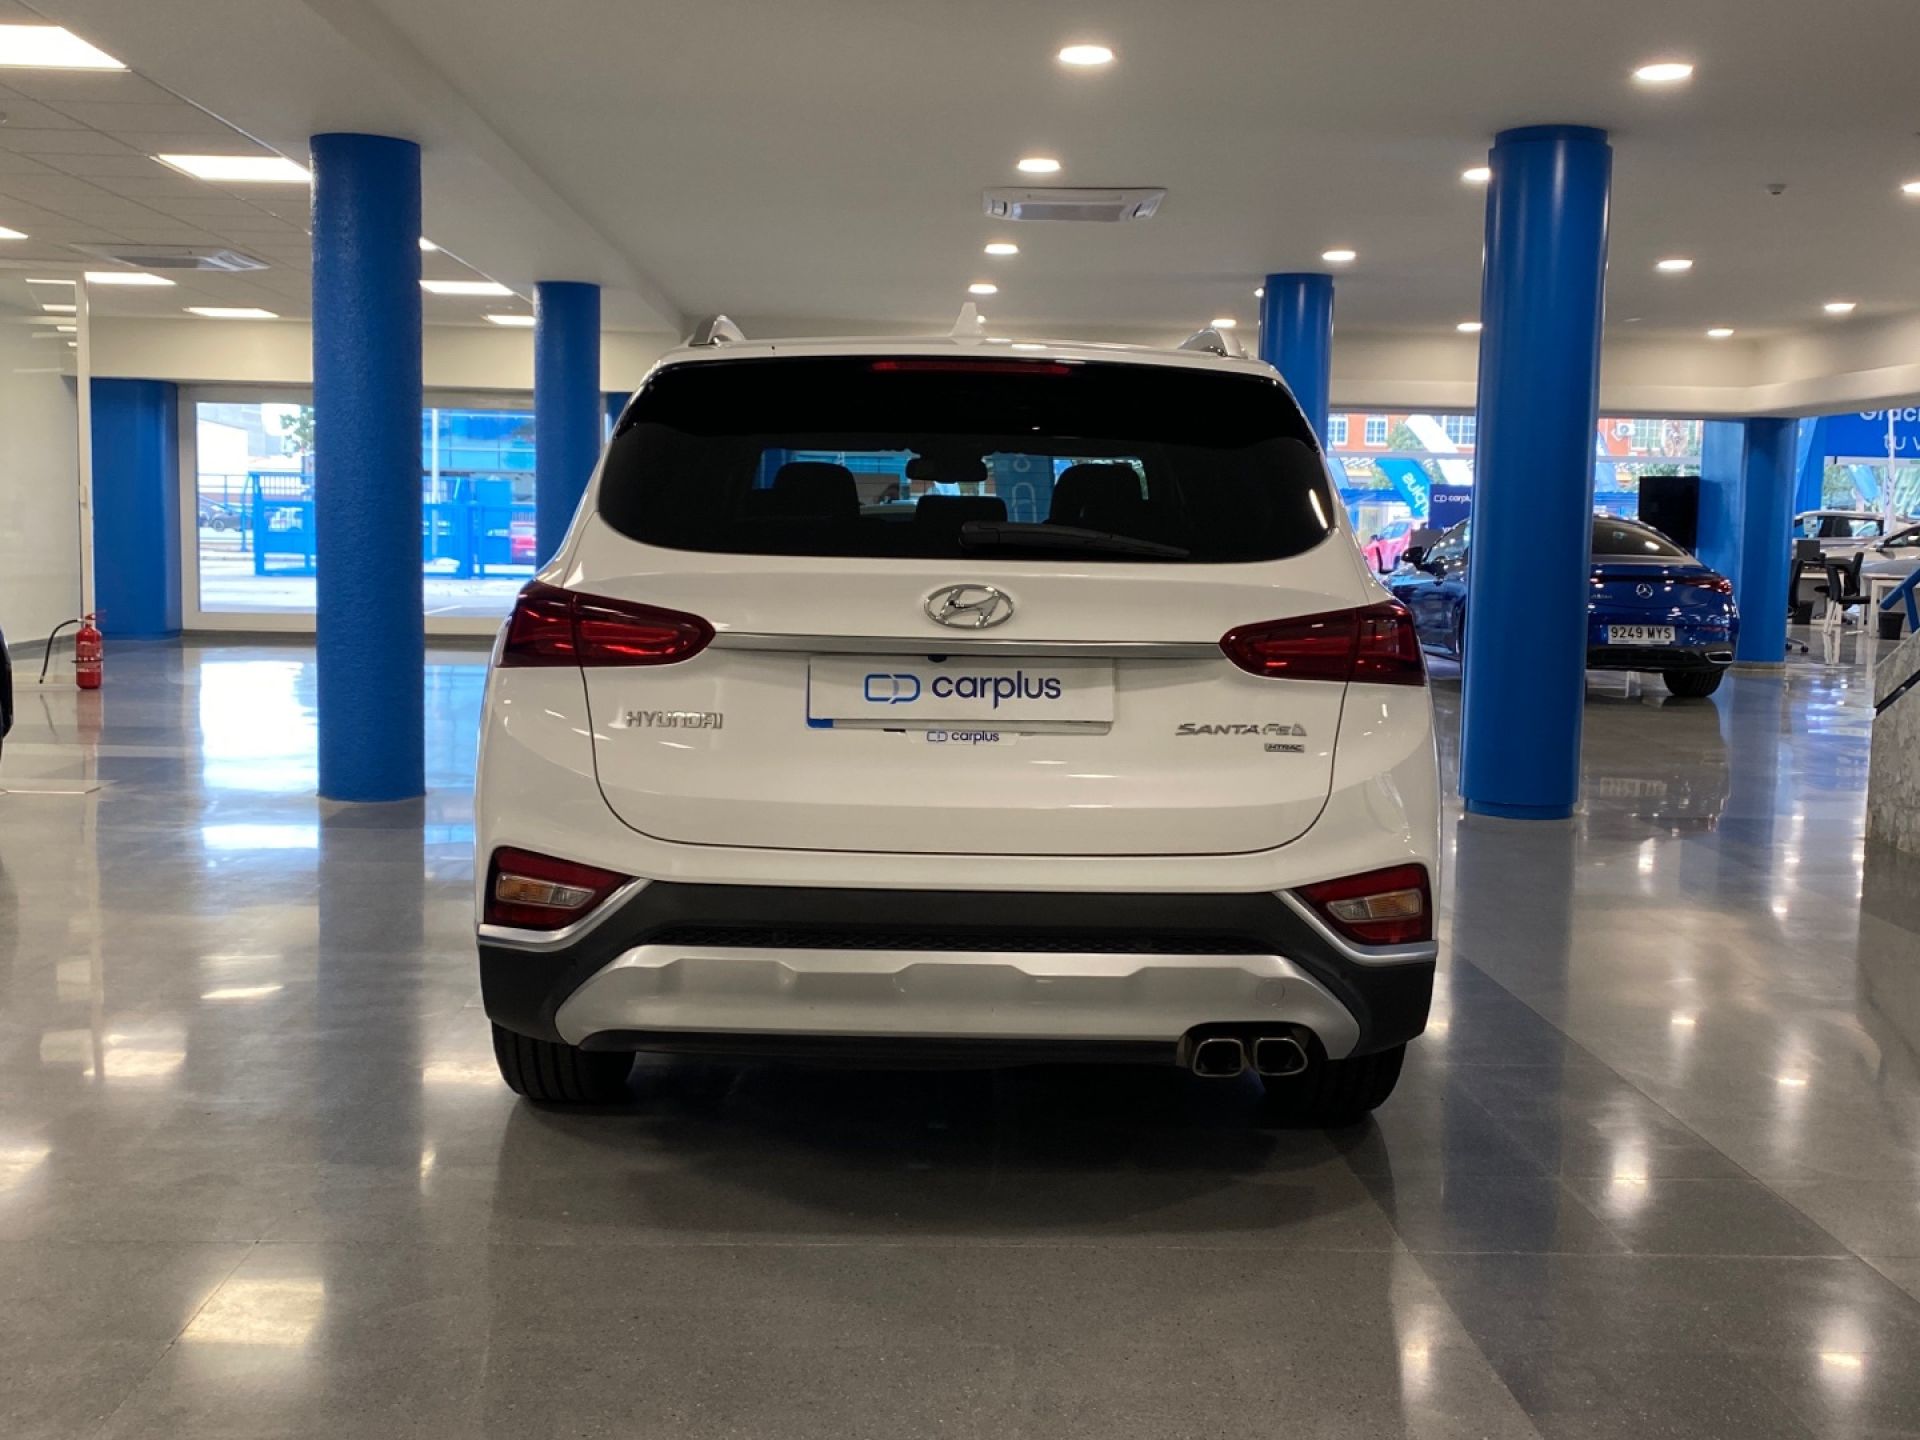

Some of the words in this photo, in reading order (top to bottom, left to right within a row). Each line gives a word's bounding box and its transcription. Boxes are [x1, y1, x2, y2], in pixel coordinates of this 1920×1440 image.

[1611, 626, 1643, 638] 9249
[1647, 627, 1672, 639] MYS
[931, 670, 1061, 709] carplus
[626, 711, 723, 730] HYUNDAI
[1175, 723, 1260, 736] SANTA
[951, 731, 1000, 745] carplus
